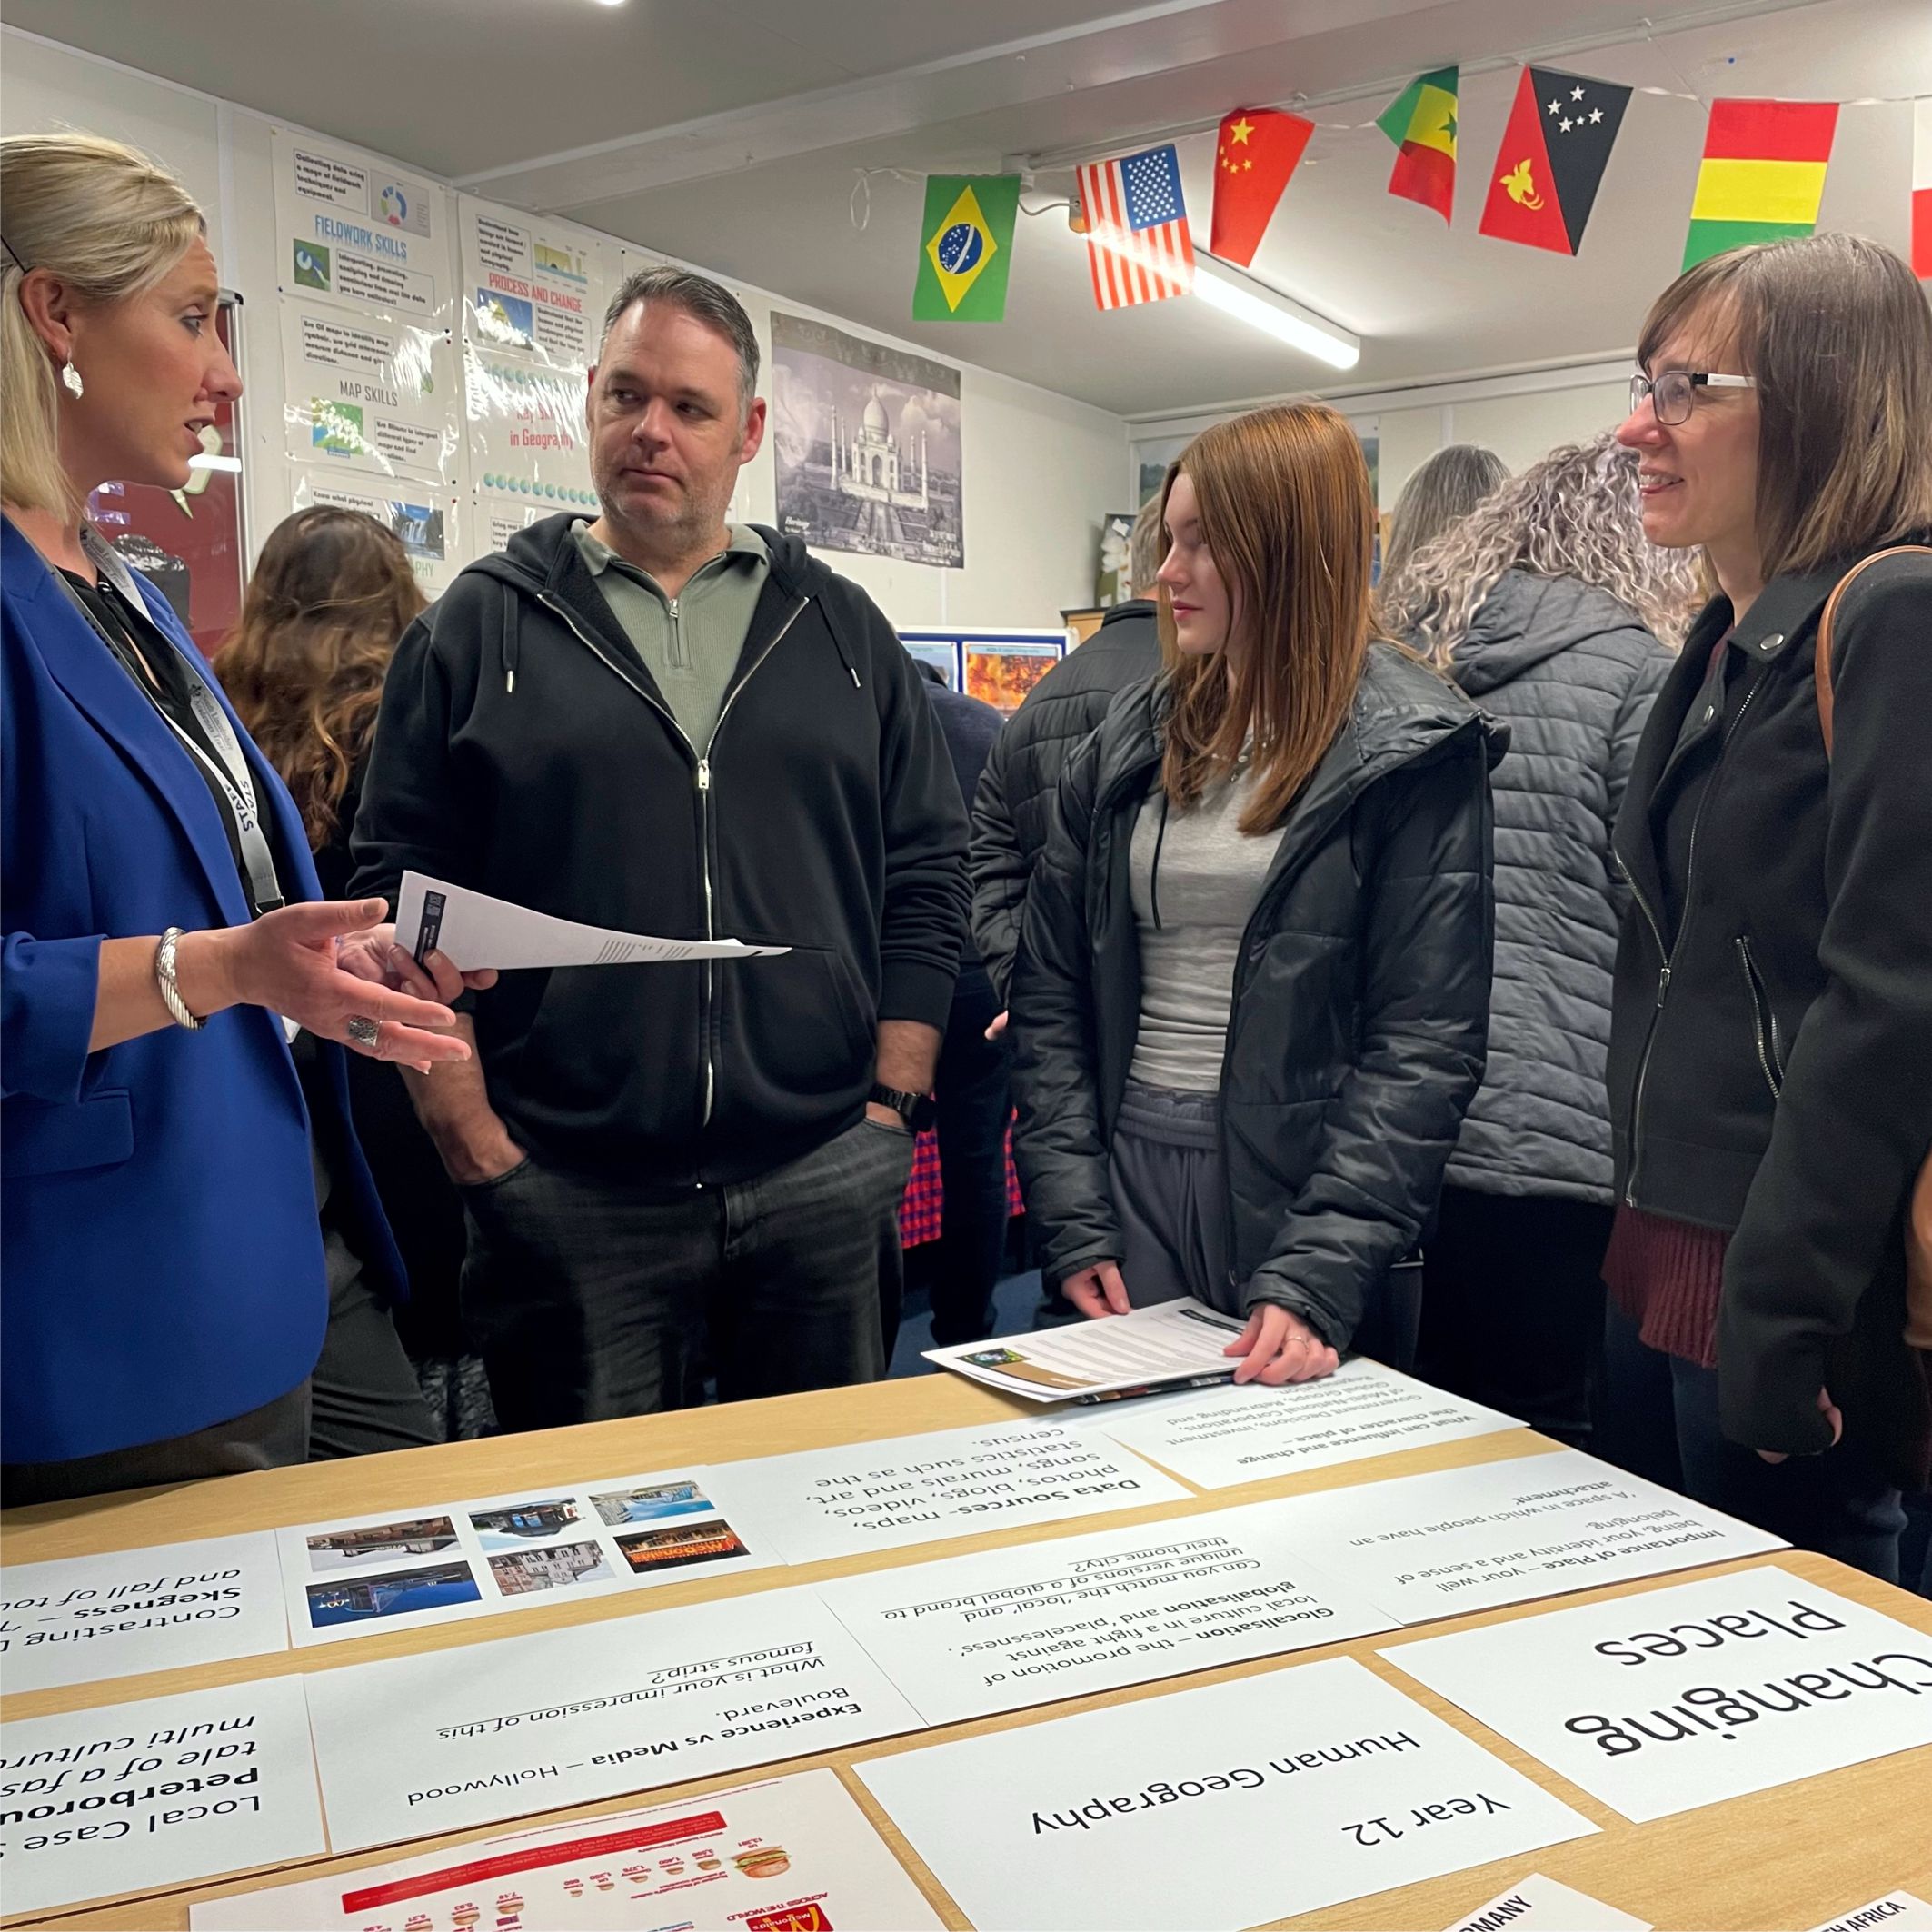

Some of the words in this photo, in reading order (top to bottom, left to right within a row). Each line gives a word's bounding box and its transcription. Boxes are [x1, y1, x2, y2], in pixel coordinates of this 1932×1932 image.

[315, 215, 373, 247] FIELDWORK
[376, 233, 407, 260] SKILLS
[489, 273, 529, 297] PROCESS
[532, 284, 548, 303] AND
[551, 291, 582, 314] CHANGE
[340, 381, 362, 398] MAP
[364, 385, 398, 407] SKILLS
[511, 430, 519, 446] in
[1429, 1408, 1458, 1416] the
[1359, 1414, 1428, 1430] character
[1401, 1424, 1429, 1432] can
[1430, 1415, 1477, 1427] What
[972, 1429, 1064, 1446] census.
[1166, 1425, 1257, 1445] investment
[1294, 1429, 1338, 1441] place
[1329, 1429, 1405, 1446] influence
[971, 1441, 1082, 1462] statistics
[1237, 1449, 1295, 1464] change
[1297, 1443, 1329, 1454] and
[904, 1459, 965, 1474] such
[1018, 1454, 1100, 1469] songs,
[815, 1475, 861, 1487] the
[868, 1469, 896, 1479] as
[921, 1467, 1012, 1487] murals
[1019, 1464, 1119, 1486] photos,
[862, 1482, 914, 1498] and
[931, 1483, 1016, 1499] blogs,
[1072, 1479, 1141, 1495] Data
[806, 1491, 854, 1504] art,
[950, 1491, 1070, 1514] Sources-
[1562, 1494, 1613, 1507] space
[824, 1498, 926, 1517] videos,
[1488, 1508, 1543, 1521] which
[853, 1511, 941, 1530] maps,
[1424, 1516, 1487, 1532] people
[1641, 1519, 1703, 1533] being,
[1349, 1538, 1375, 1546] an
[1377, 1529, 1426, 1541] have
[1602, 1529, 1645, 1543] your
[1617, 1530, 1726, 1554] Importance
[1184, 1537, 1228, 1550] their
[1529, 1539, 1604, 1557] identity
[1124, 1546, 1180, 1560] home
[1180, 1548, 1243, 1565] unique
[1490, 1552, 1528, 1566] and
[1595, 1550, 1617, 1560] of
[1075, 1557, 1119, 1573] city?
[1223, 1559, 1260, 1571] Can
[1541, 1555, 1597, 1569] Place
[174, 1569, 240, 1588] and
[1094, 1561, 1175, 1580] versions
[1183, 1567, 1220, 1578] you
[1417, 1563, 1473, 1578] sense
[1481, 1567, 1526, 1582] your
[1068, 1577, 1089, 1588] of
[1115, 1575, 1178, 1592] match
[1394, 1574, 1415, 1585] of
[1435, 1578, 1479, 1592] well
[107, 1578, 169, 1598] fall
[981, 1584, 1044, 1604] global
[1077, 1587, 1110, 1598] the
[56, 1590, 97, 1606] of
[74, 1588, 241, 1618] Skegness
[1163, 1581, 1296, 1613] globalisation
[1266, 1595, 1318, 1611] local
[884, 1610, 907, 1619] to
[913, 1598, 976, 1617] brand
[964, 1608, 1003, 1623] and
[1189, 1605, 1262, 1624] culture
[1119, 1609, 1160, 1624] and
[1163, 1620, 1188, 1628] in
[1195, 1608, 1334, 1639] Glocalisation
[25, 1607, 240, 1646] Contrasting
[1594, 1601, 1846, 1667] Places
[1090, 1628, 1143, 1645] fight
[1006, 1639, 1087, 1661] against
[1135, 1639, 1175, 1651] the
[727, 1641, 813, 1667] famous
[1011, 1646, 1132, 1677] promotion
[652, 1661, 720, 1684] strip?
[760, 1656, 825, 1678] What
[673, 1676, 728, 1694] your
[735, 1672, 752, 1682] is
[983, 1673, 1006, 1687] of
[530, 1688, 665, 1722] impression
[716, 1688, 850, 1722] Boulevard.
[1564, 1651, 1932, 1757] Changing
[493, 1718, 520, 1732] of
[720, 1703, 862, 1738] Experience
[147, 1716, 254, 1748] multi
[439, 1724, 486, 1740] this
[684, 1734, 714, 1746] vs
[177, 1741, 255, 1766] tale
[591, 1740, 679, 1765] Media
[1269, 1730, 1420, 1778] Human
[80, 1768, 105, 1783] a
[114, 1758, 162, 1781] of
[407, 1765, 558, 1806] Hollywood
[1031, 1768, 1264, 1835] Geography
[149, 1796, 259, 1832] Local
[1409, 1791, 1511, 1831] Year
[24, 1821, 130, 1849] Case
[1341, 1817, 1404, 1847] 12
[766, 1902, 786, 1912] THE
[787, 1892, 828, 1907] ACROSS
[726, 1907, 765, 1921] WORLD
[1845, 1901, 1907, 1931] AFRICA
